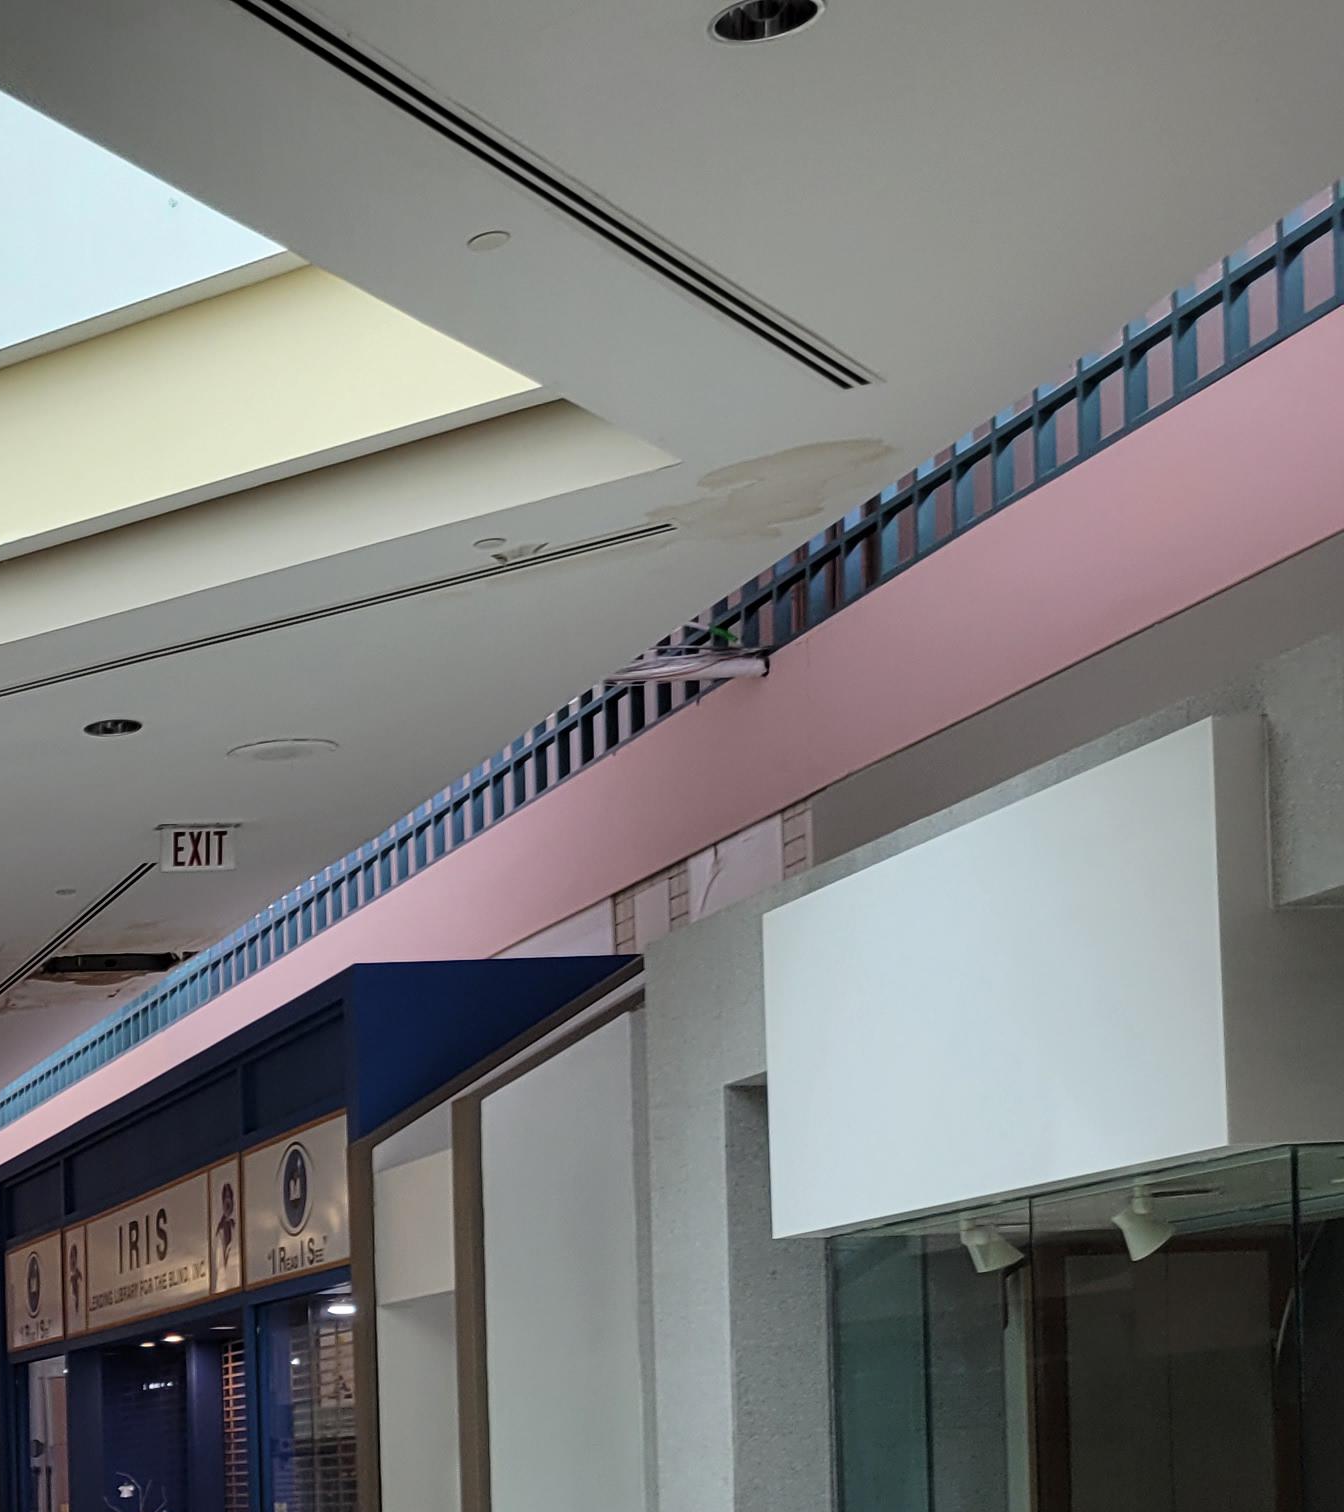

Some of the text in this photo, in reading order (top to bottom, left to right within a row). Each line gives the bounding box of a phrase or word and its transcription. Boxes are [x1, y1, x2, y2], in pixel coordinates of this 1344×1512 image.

[172, 830, 228, 867] EXIT
[119, 1208, 168, 1274] IRIS
[139, 1277, 153, 1297] FOR
[153, 1271, 167, 1291] THE
